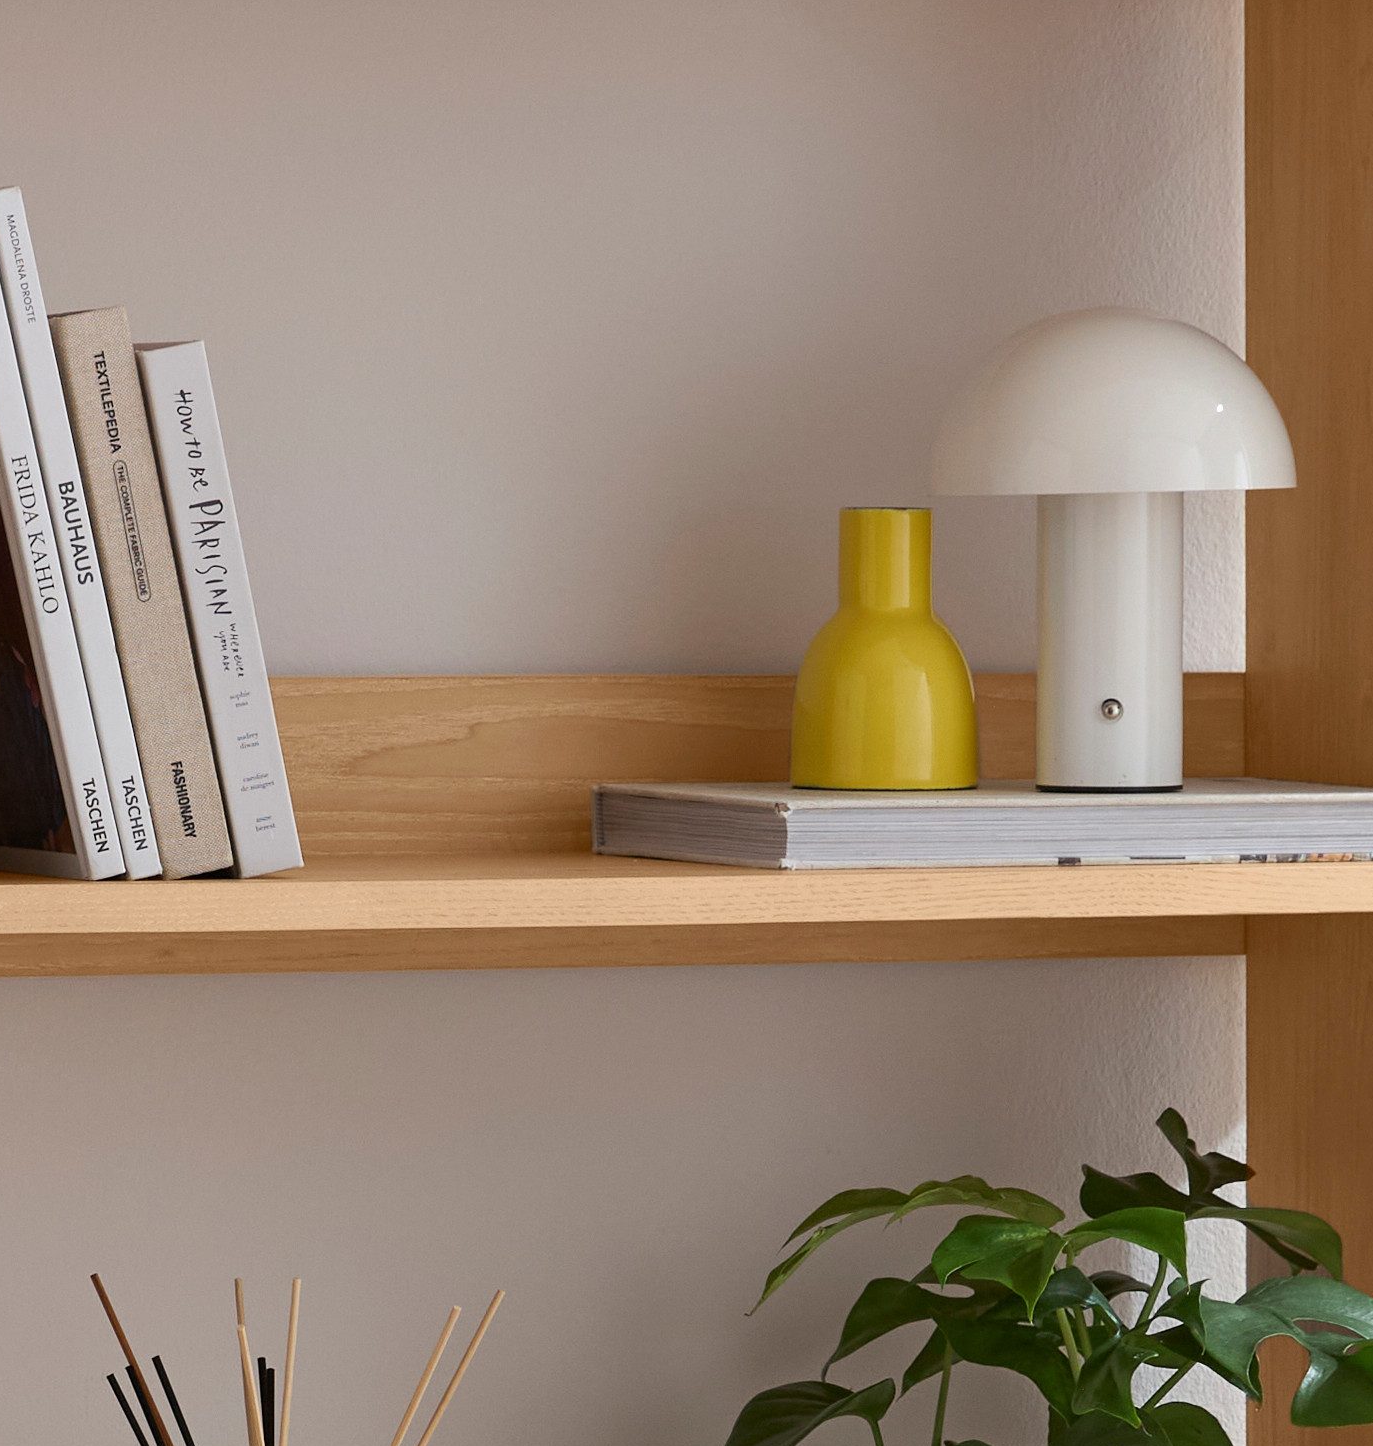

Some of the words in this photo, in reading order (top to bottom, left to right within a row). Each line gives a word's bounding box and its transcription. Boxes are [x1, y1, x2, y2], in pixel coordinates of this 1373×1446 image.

[6, 214, 26, 281] MAGDALENA
[20, 282, 36, 325] DROSTE
[94, 350, 122, 454] TEXTILEPEDIA
[117, 466, 127, 484] THE
[120, 485, 136, 533] COMPLETE
[11, 454, 39, 526] FRIDA
[28, 530, 59, 614] KAHLO
[58, 480, 94, 585] BAUHAUS
[129, 534, 143, 567] FABRIC
[189, 499, 232, 615] PARISIAN
[136, 568, 148, 596] GUIDE
[82, 777, 109, 853] TASCHEN
[122, 775, 148, 851] TASCHEN
[170, 760, 197, 838] FASHIONARY
